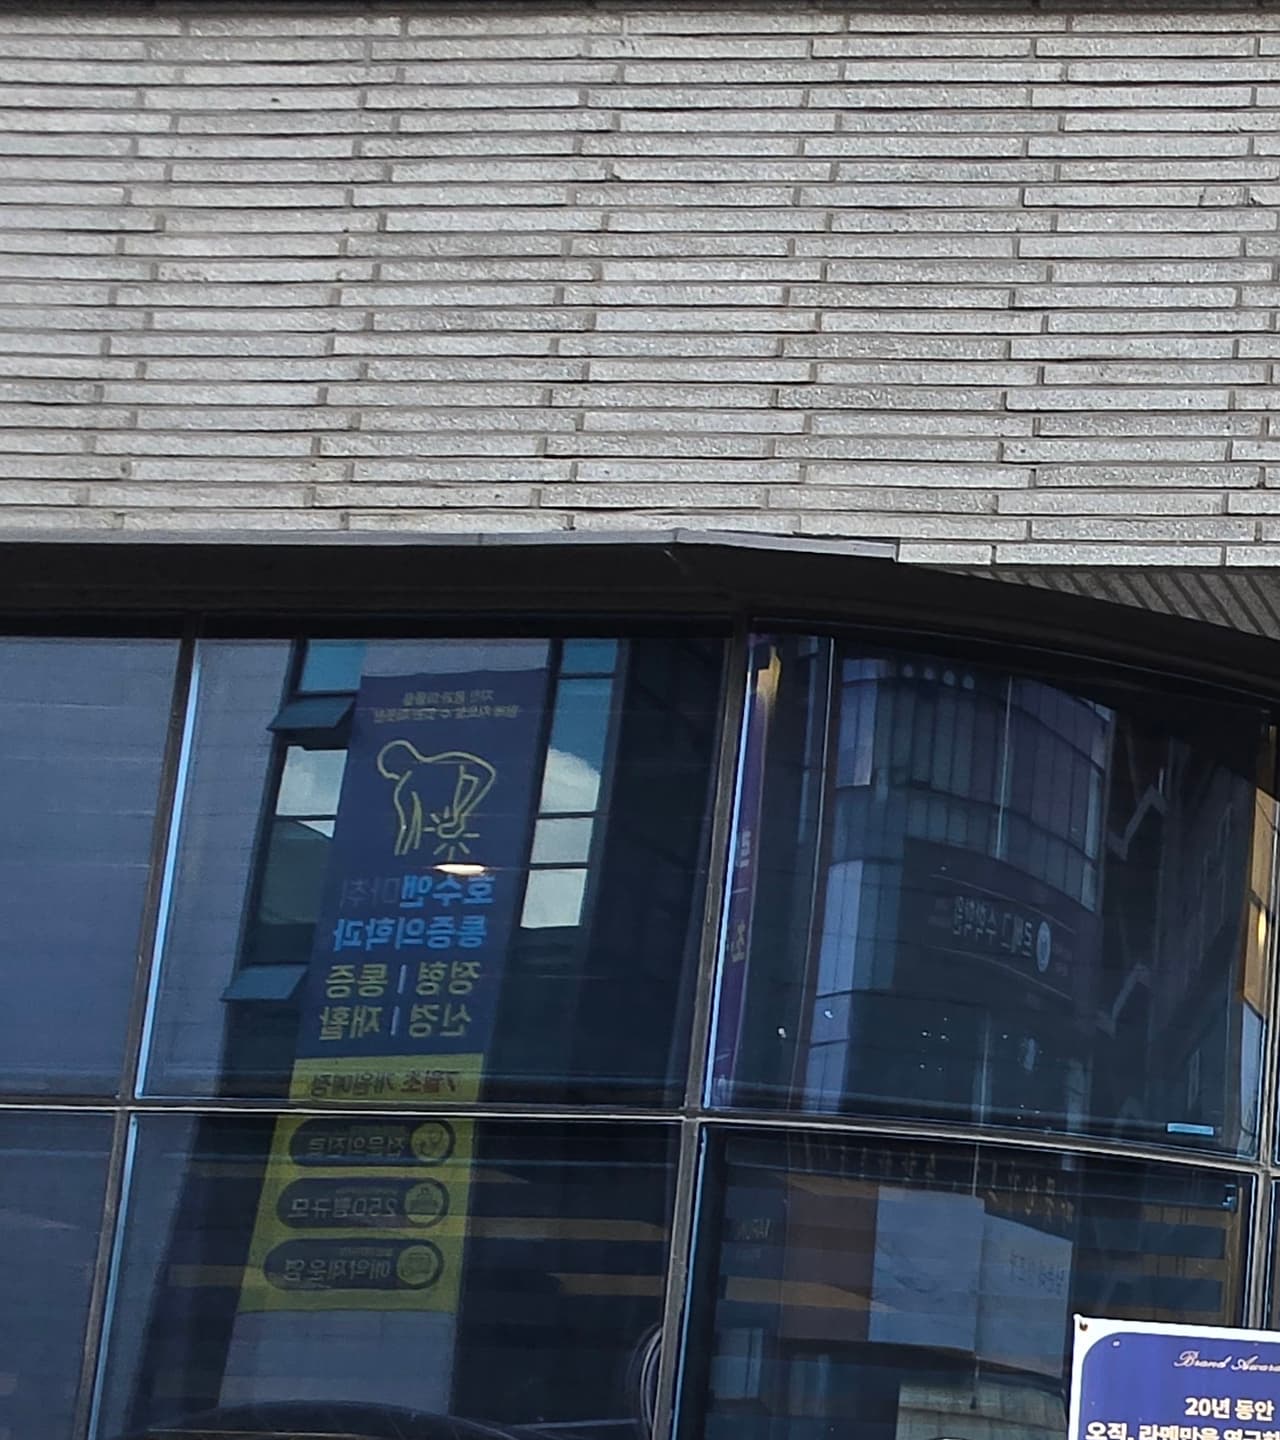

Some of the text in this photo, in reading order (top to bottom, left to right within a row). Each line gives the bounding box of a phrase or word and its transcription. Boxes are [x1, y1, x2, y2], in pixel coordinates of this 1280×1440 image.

[1173, 1350, 1227, 1369] Brand
[1184, 1398, 1275, 1422] 20년 동안
